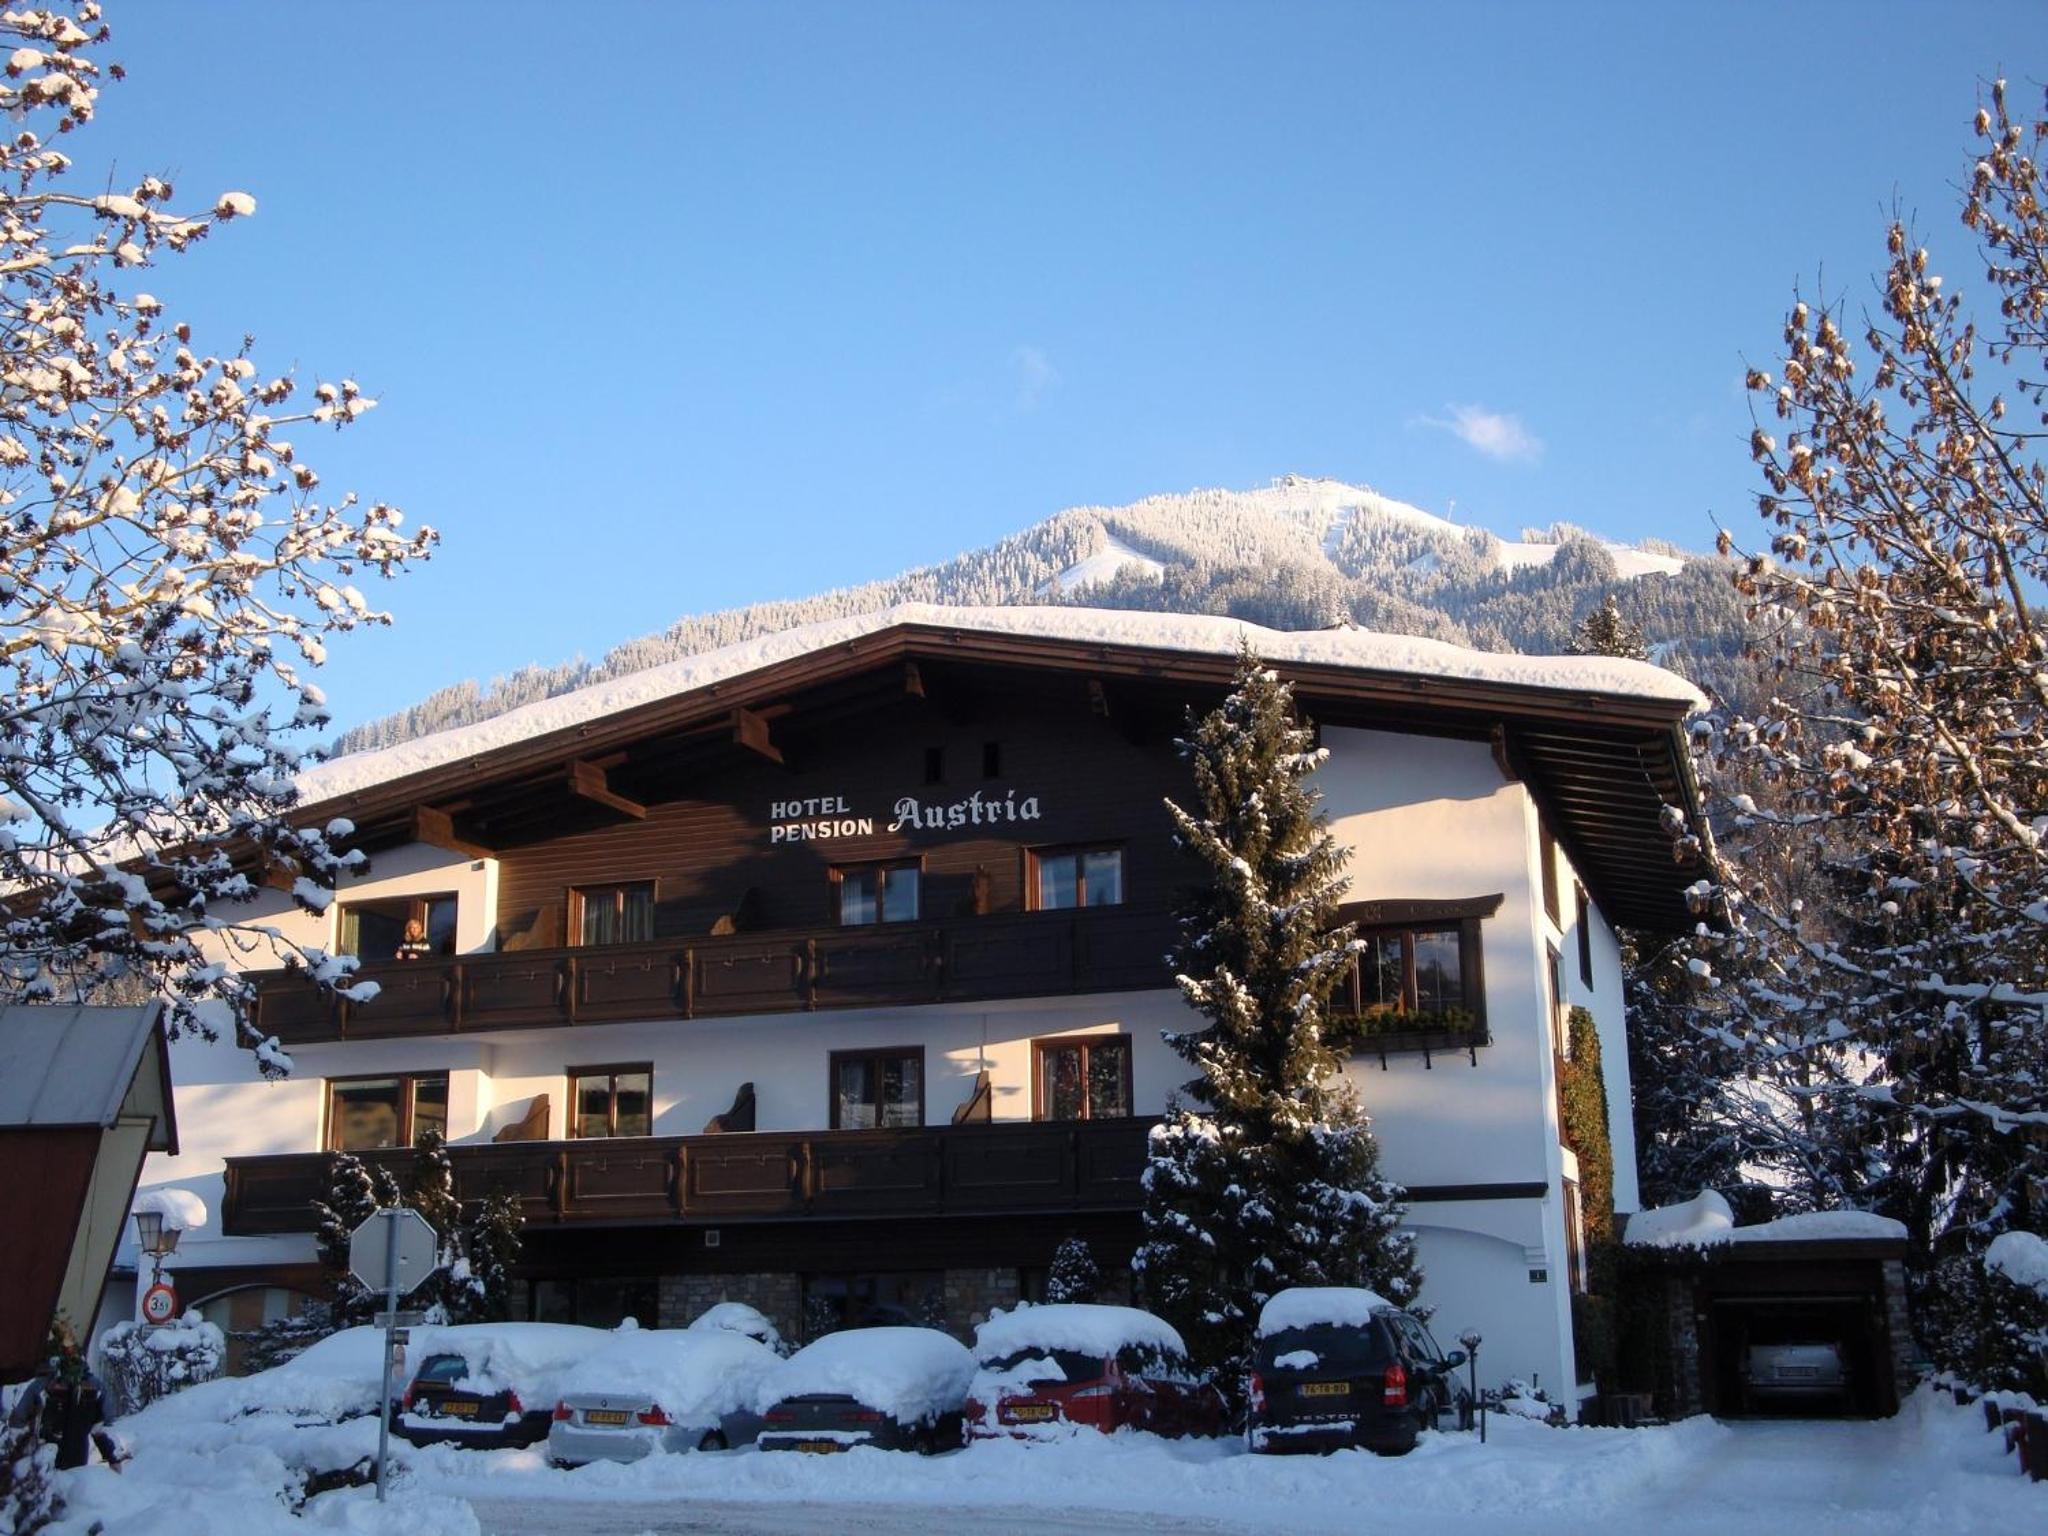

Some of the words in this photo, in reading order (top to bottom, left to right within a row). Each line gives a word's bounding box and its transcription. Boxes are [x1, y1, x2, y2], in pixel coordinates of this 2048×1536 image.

[770, 796, 850, 819] HOTEL
[887, 789, 1041, 833] Austria
[770, 818, 873, 843] PENSION
